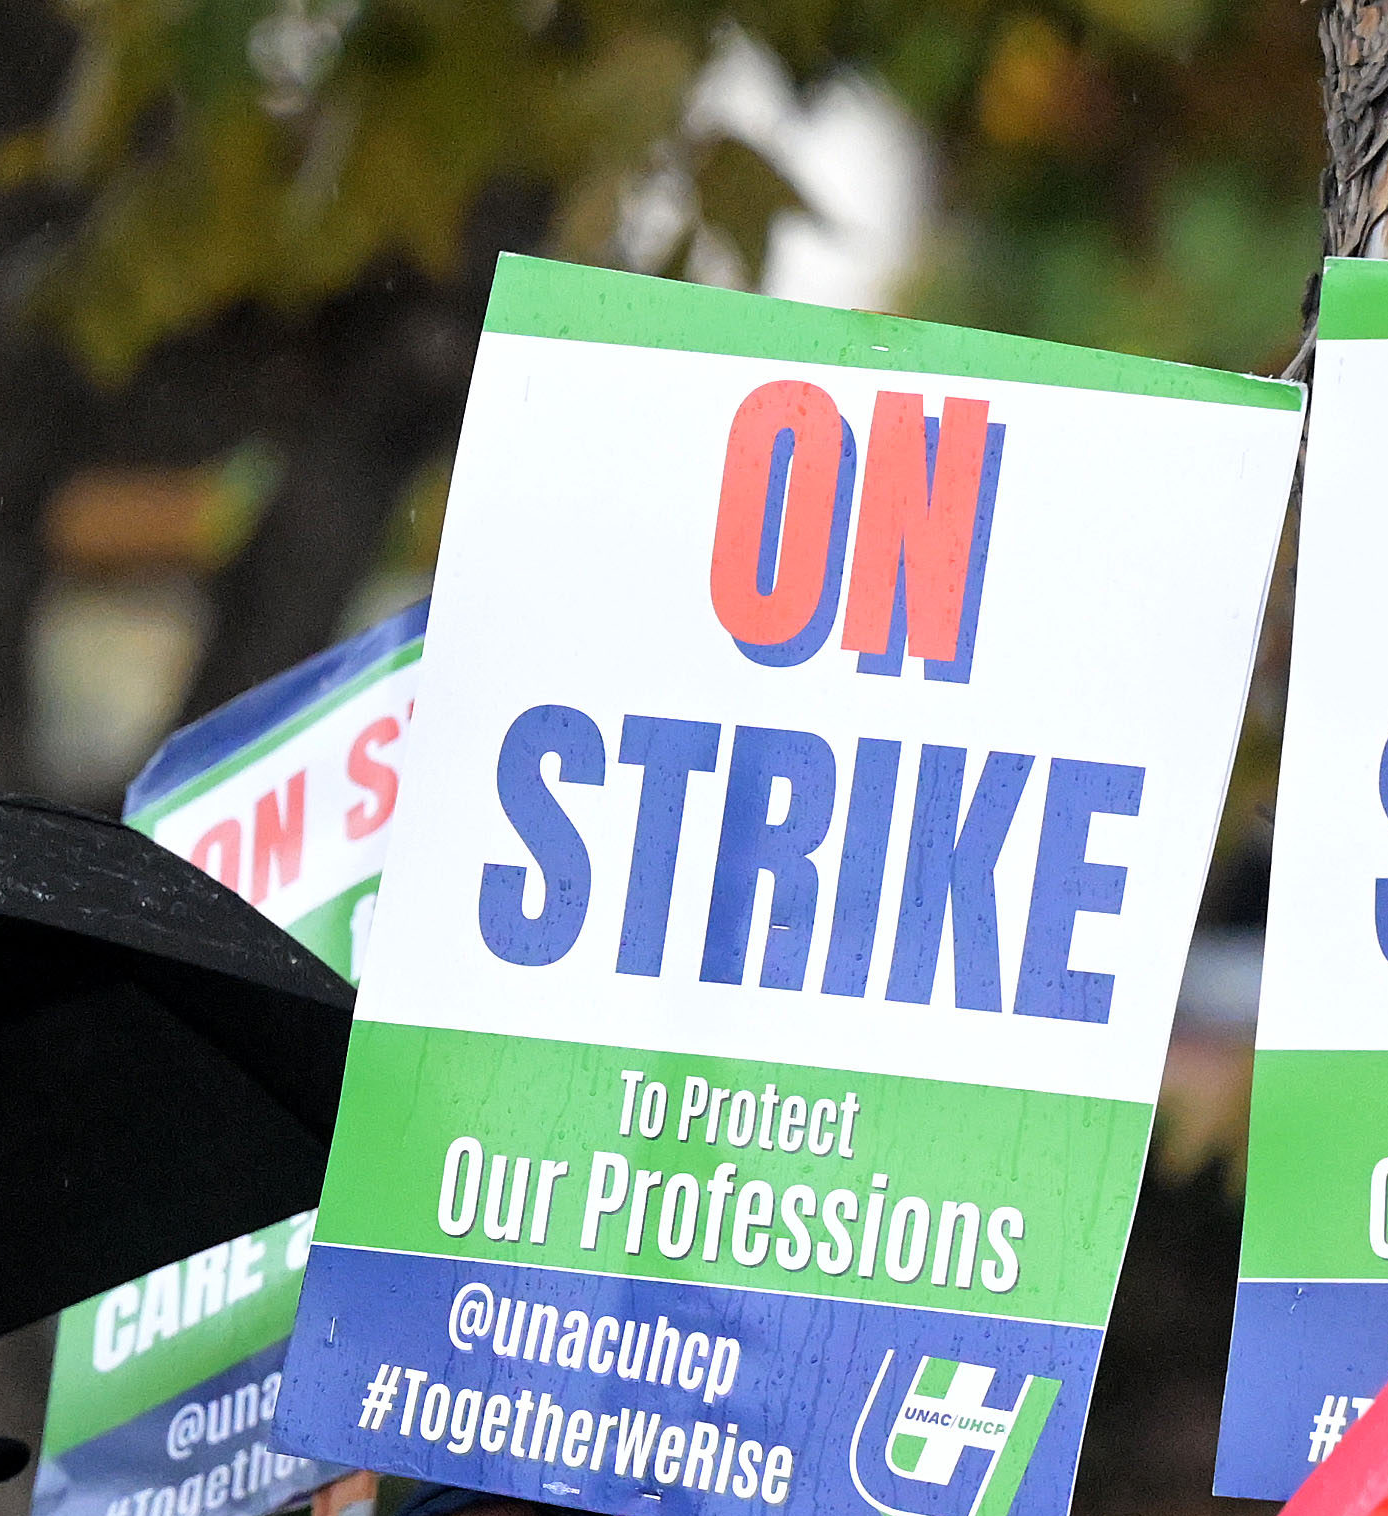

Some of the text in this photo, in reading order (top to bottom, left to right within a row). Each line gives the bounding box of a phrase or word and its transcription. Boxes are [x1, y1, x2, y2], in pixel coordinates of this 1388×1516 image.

[709, 379, 1006, 684] ON
[190, 768, 306, 907] ON
[478, 704, 1146, 1025] STRIKE
[618, 1069, 860, 1159] To Protect
[436, 1135, 1025, 1294] Our Professions
[92, 1235, 266, 1372] CARE
[448, 1282, 742, 1404] @unacuhcp
[358, 1362, 794, 1505] #TogetherWeRise
[904, 1406, 1006, 1435] UNAC/UHCP
